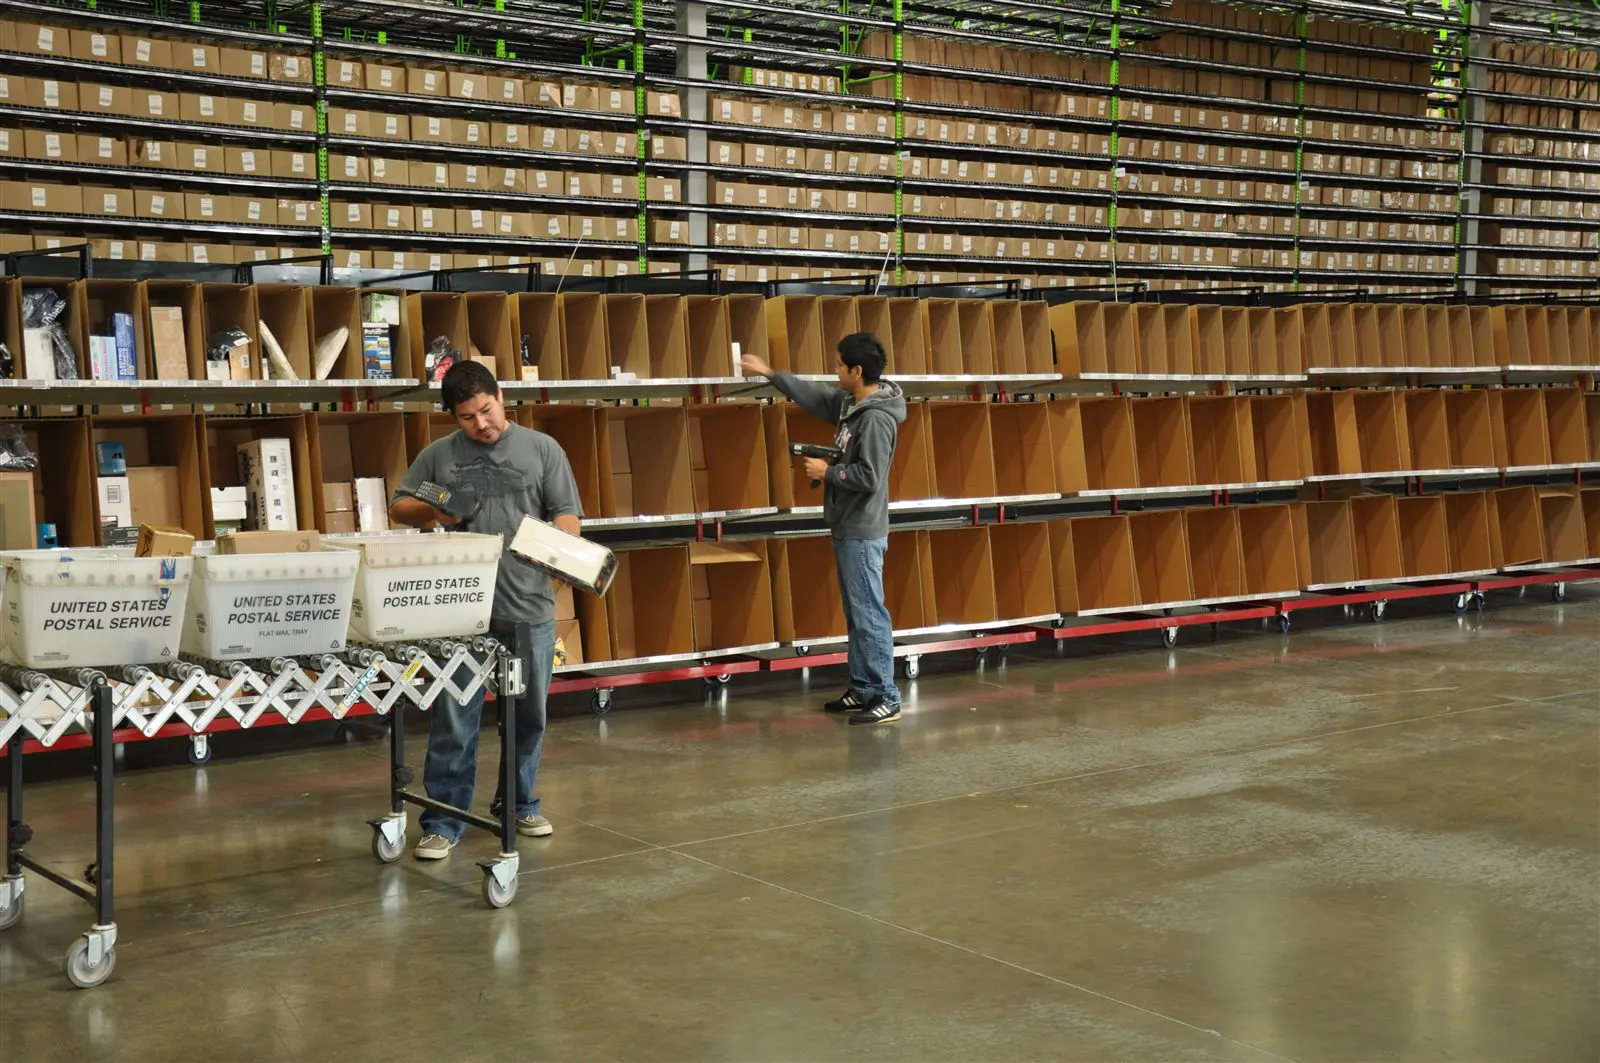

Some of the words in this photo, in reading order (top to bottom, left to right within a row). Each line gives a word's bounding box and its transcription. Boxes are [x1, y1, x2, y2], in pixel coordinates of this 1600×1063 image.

[387, 579, 432, 593] UNITED
[434, 576, 480, 590] STATES
[50, 601, 107, 614] UNITED
[110, 599, 168, 612] STATES
[233, 595, 283, 608] UNITED
[285, 593, 337, 606] STATES
[382, 595, 431, 608] POSTAL
[434, 591, 485, 605] SERVICE
[43, 619, 105, 631] POSTAL
[109, 615, 173, 629] SERVICE
[227, 612, 281, 625] POSTAL
[284, 608, 341, 622] SERVICE
[258, 629, 276, 637] FLAT
[291, 628, 309, 636] TRAY
